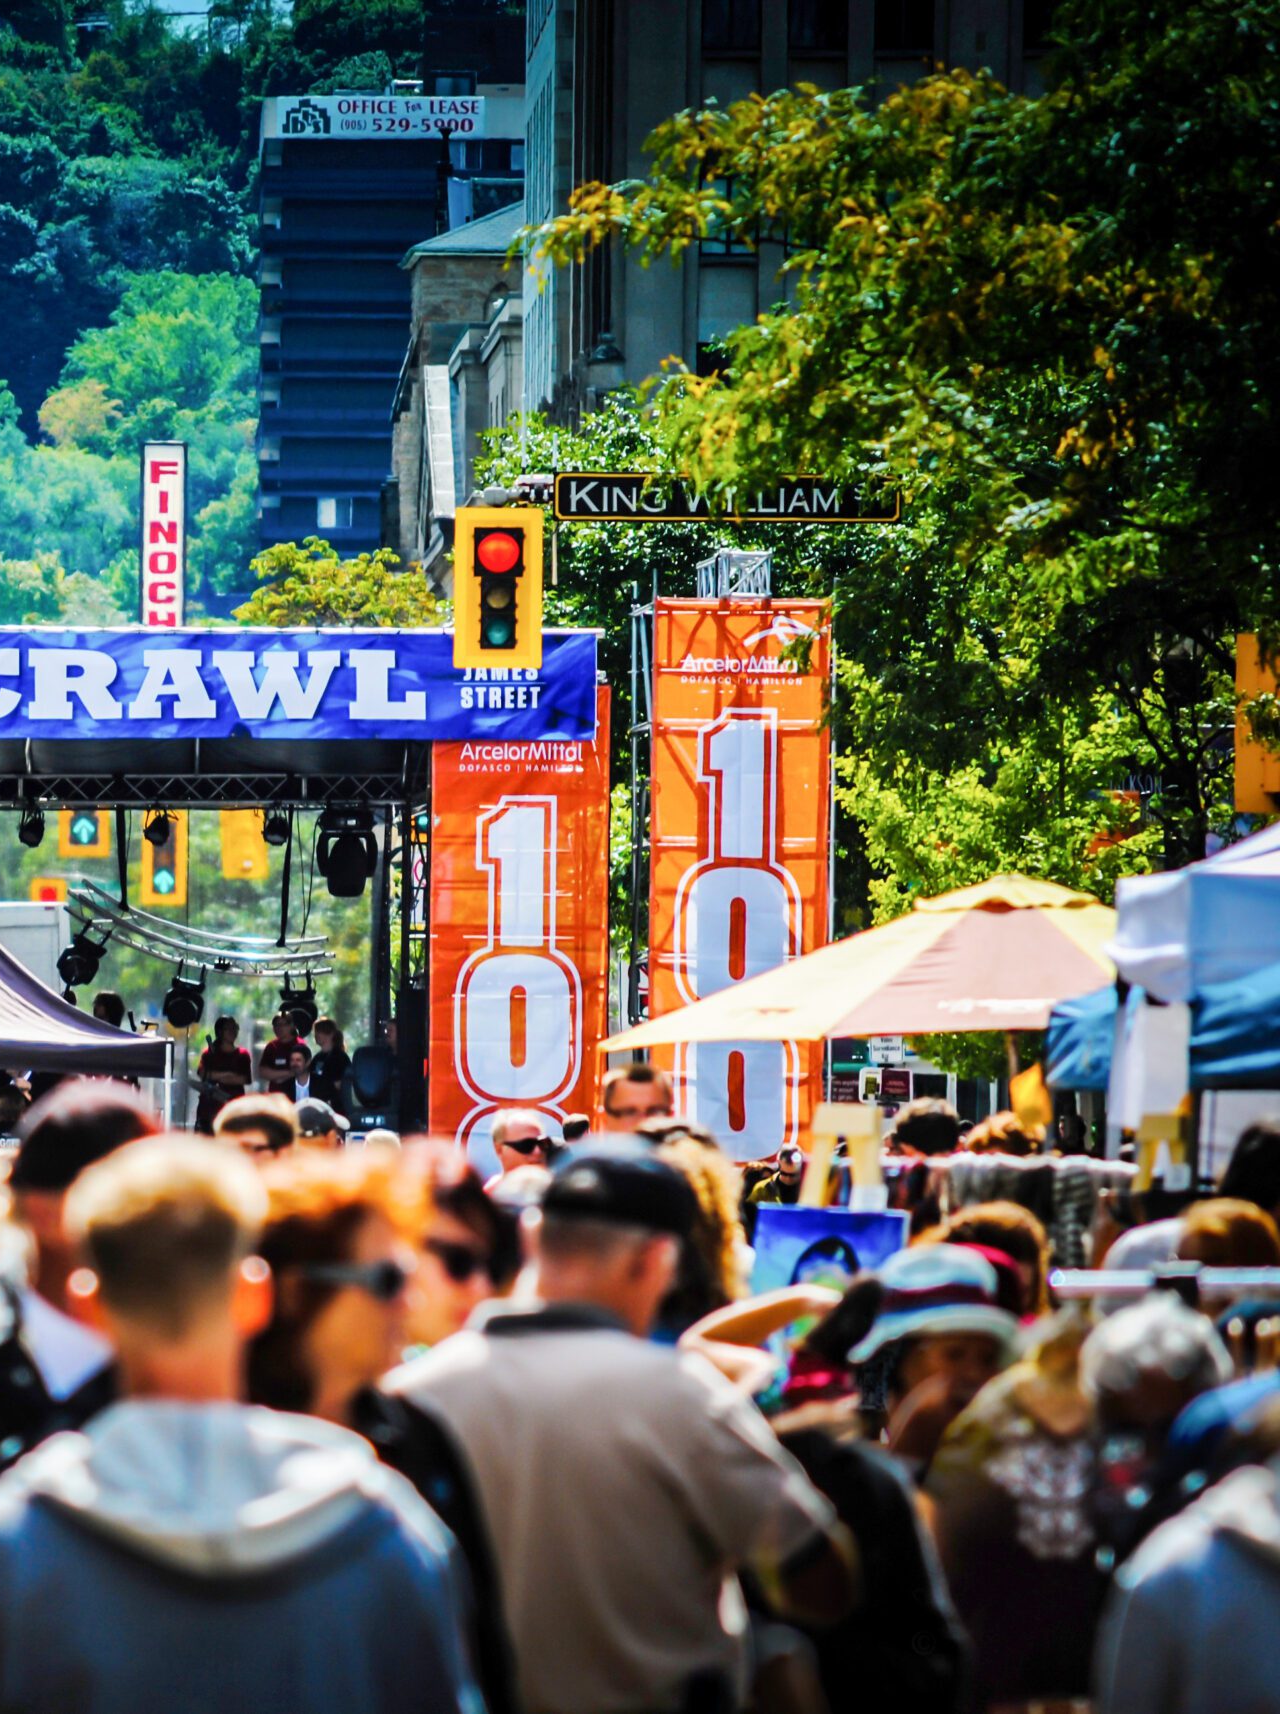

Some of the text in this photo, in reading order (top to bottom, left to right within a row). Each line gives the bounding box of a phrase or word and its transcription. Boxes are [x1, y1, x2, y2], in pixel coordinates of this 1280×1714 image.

[337, 100, 397, 114] OFFICE
[430, 100, 479, 114] LEASE
[372, 118, 474, 132] 529-5900
[569, 480, 667, 513] KING
[746, 677, 802, 685] HAMILTON
[460, 686, 541, 709] STREET
[460, 743, 583, 762] ArcelorMittal
[459, 764, 511, 772] DOFASCO
